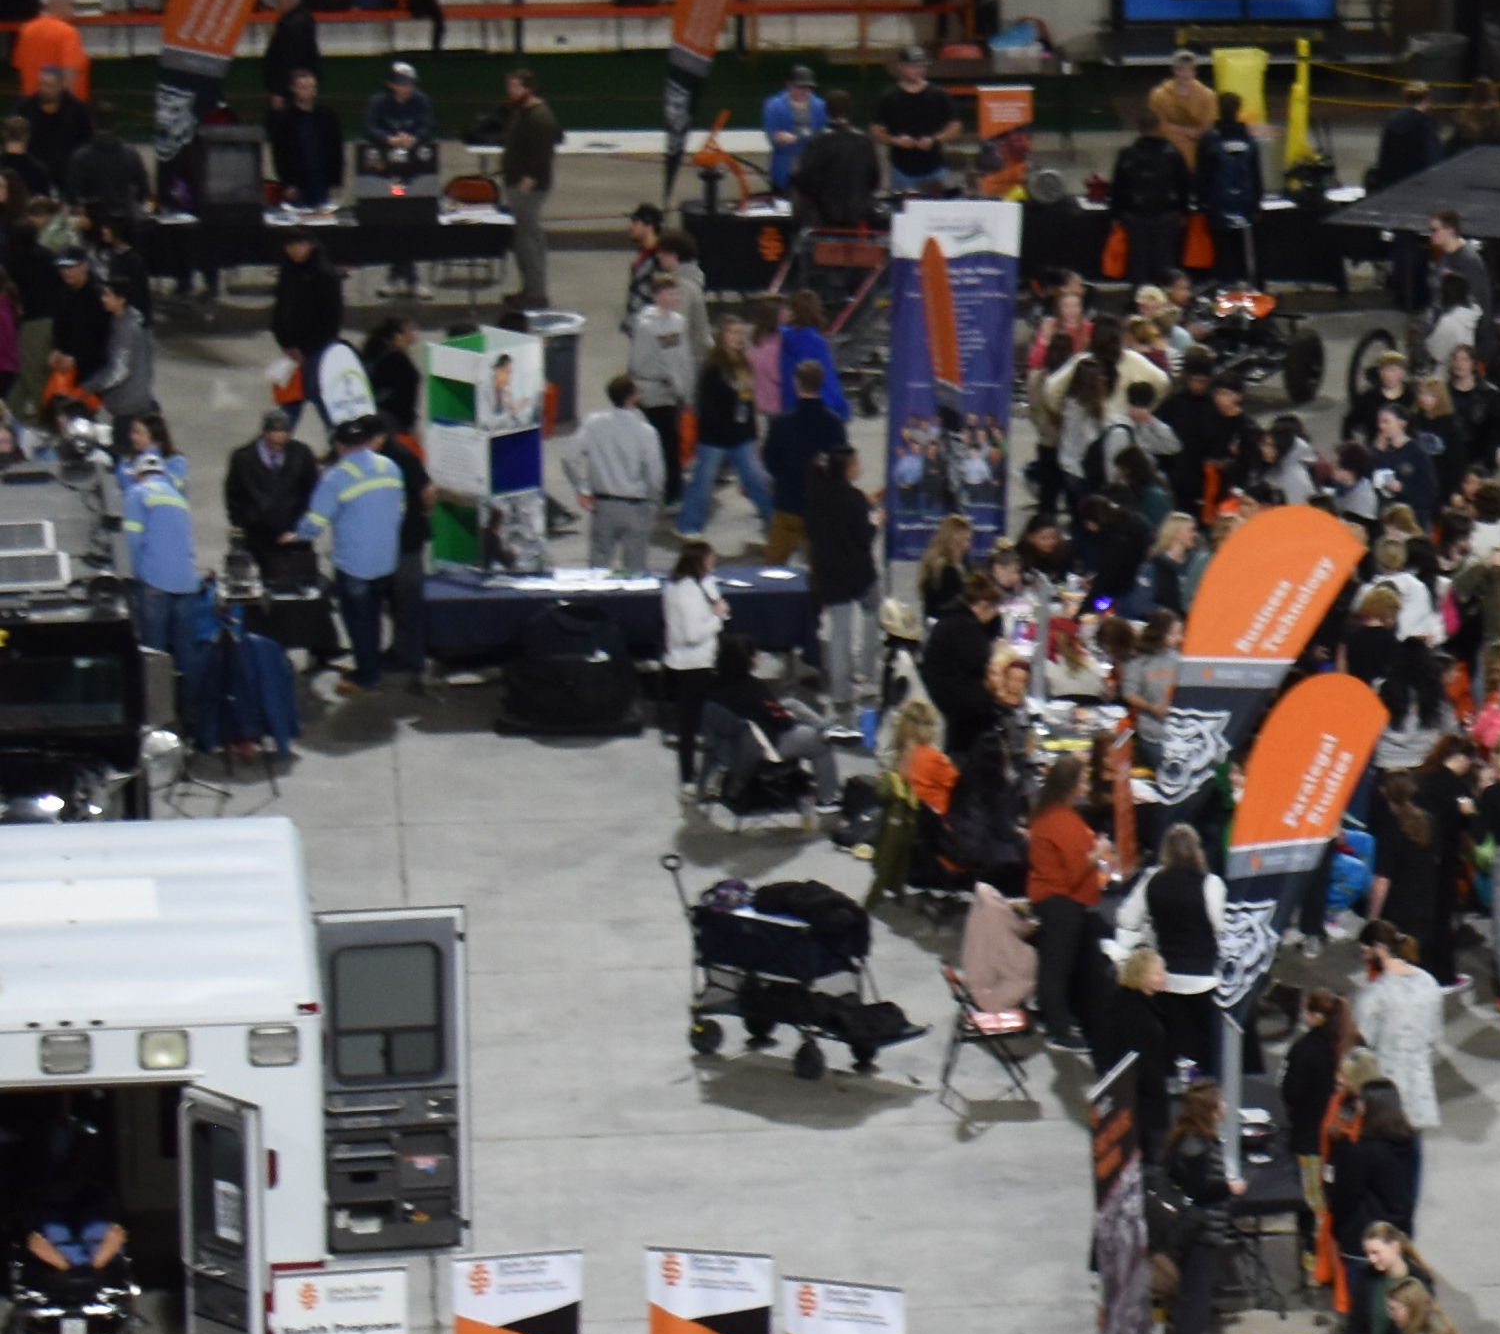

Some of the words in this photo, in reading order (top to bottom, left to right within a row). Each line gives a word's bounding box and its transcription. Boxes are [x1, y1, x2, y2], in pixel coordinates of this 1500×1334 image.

[1233, 578, 1293, 653] Business
[1260, 555, 1336, 652] Technology
[1281, 731, 1340, 828] Paralegal
[1306, 750, 1355, 826] Studies
